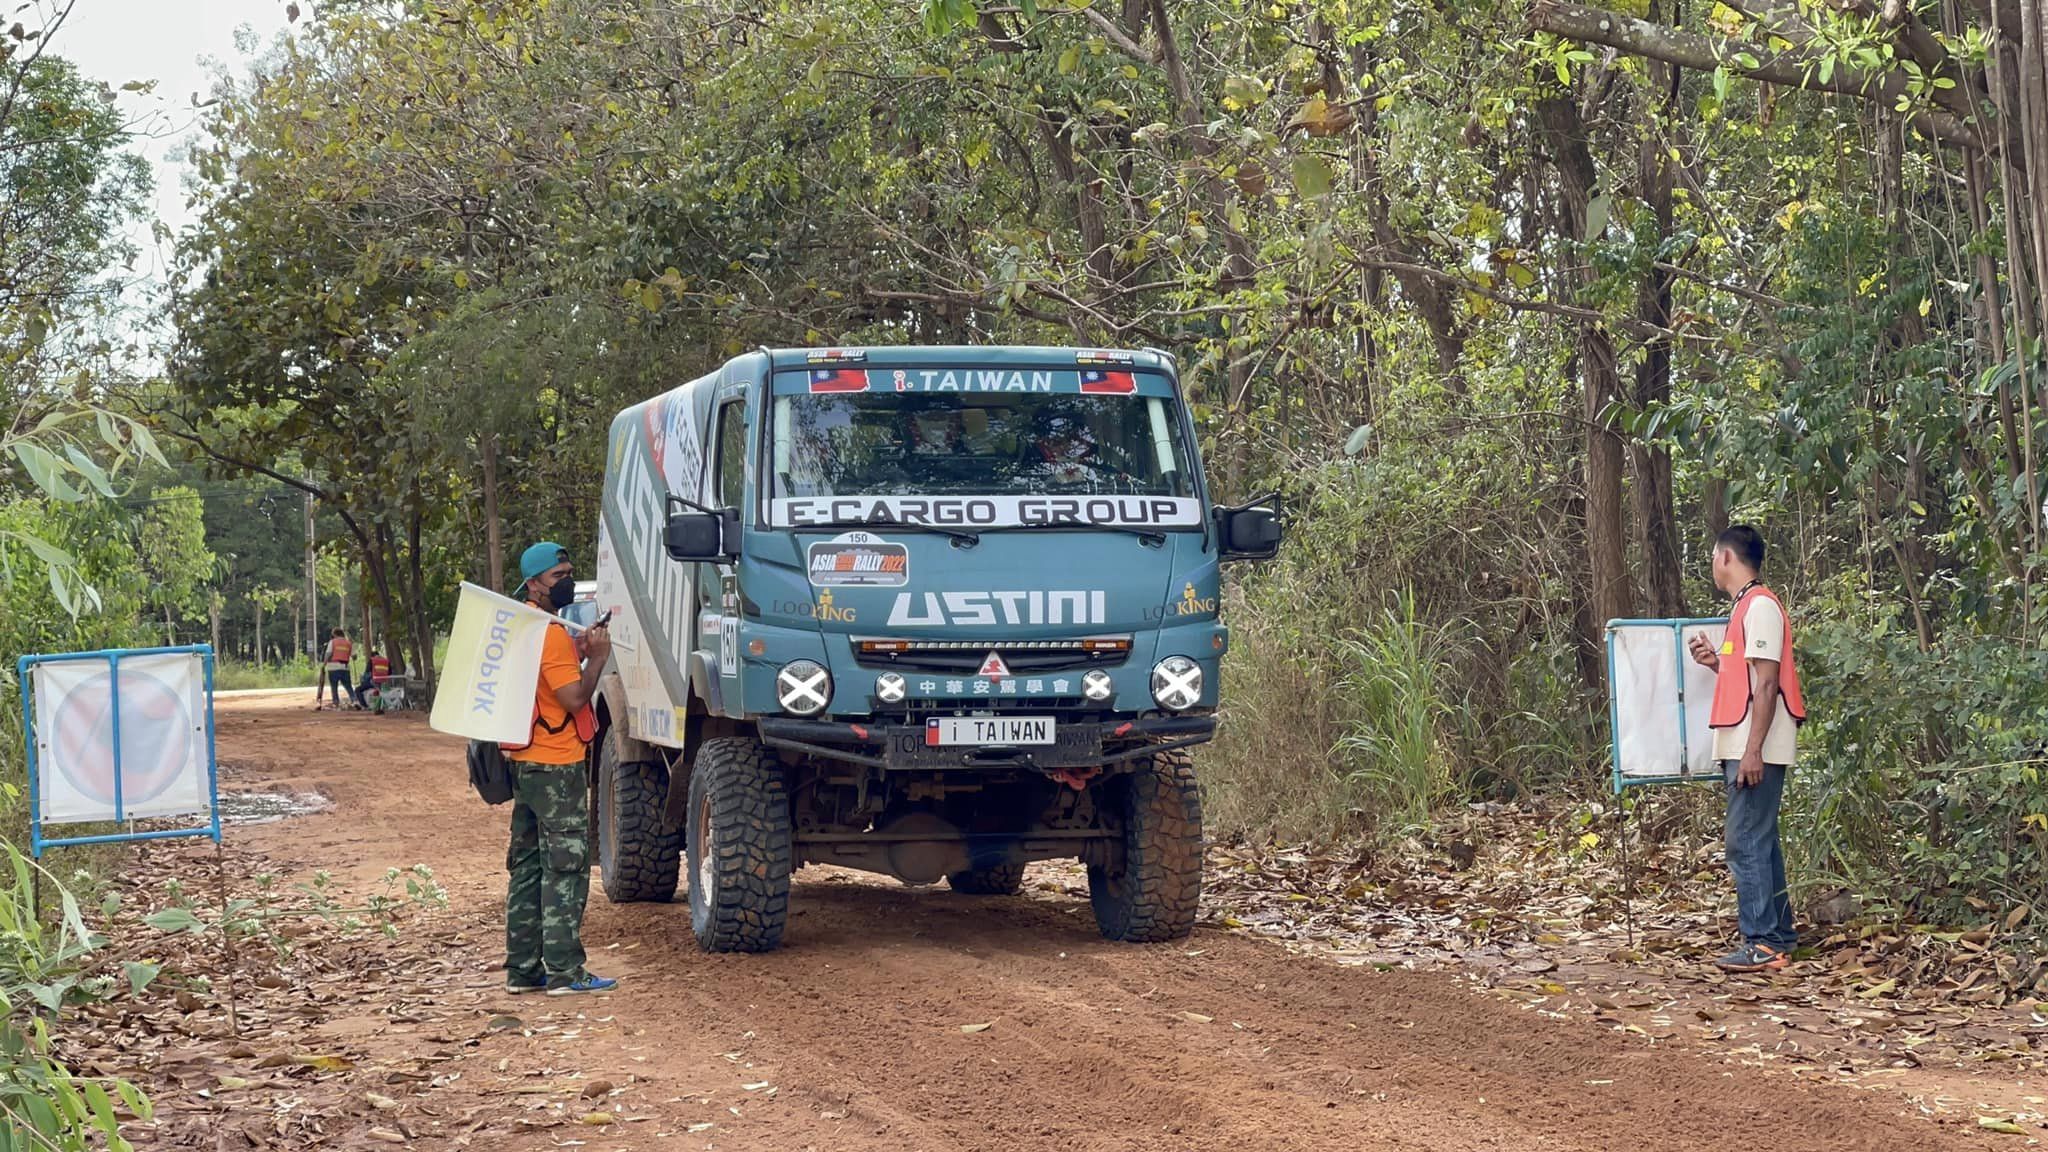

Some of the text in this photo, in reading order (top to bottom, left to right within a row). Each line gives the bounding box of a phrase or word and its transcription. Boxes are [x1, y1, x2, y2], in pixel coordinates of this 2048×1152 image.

[920, 371, 1052, 391] TAIWAN
[787, 499, 1178, 524] E-CARGO GROUP
[849, 534, 868, 543] 150
[811, 554, 837, 571] ASIA
[853, 554, 885, 571] RALLY
[888, 590, 1105, 626] USTINI
[974, 721, 1047, 742] TAIWAN
